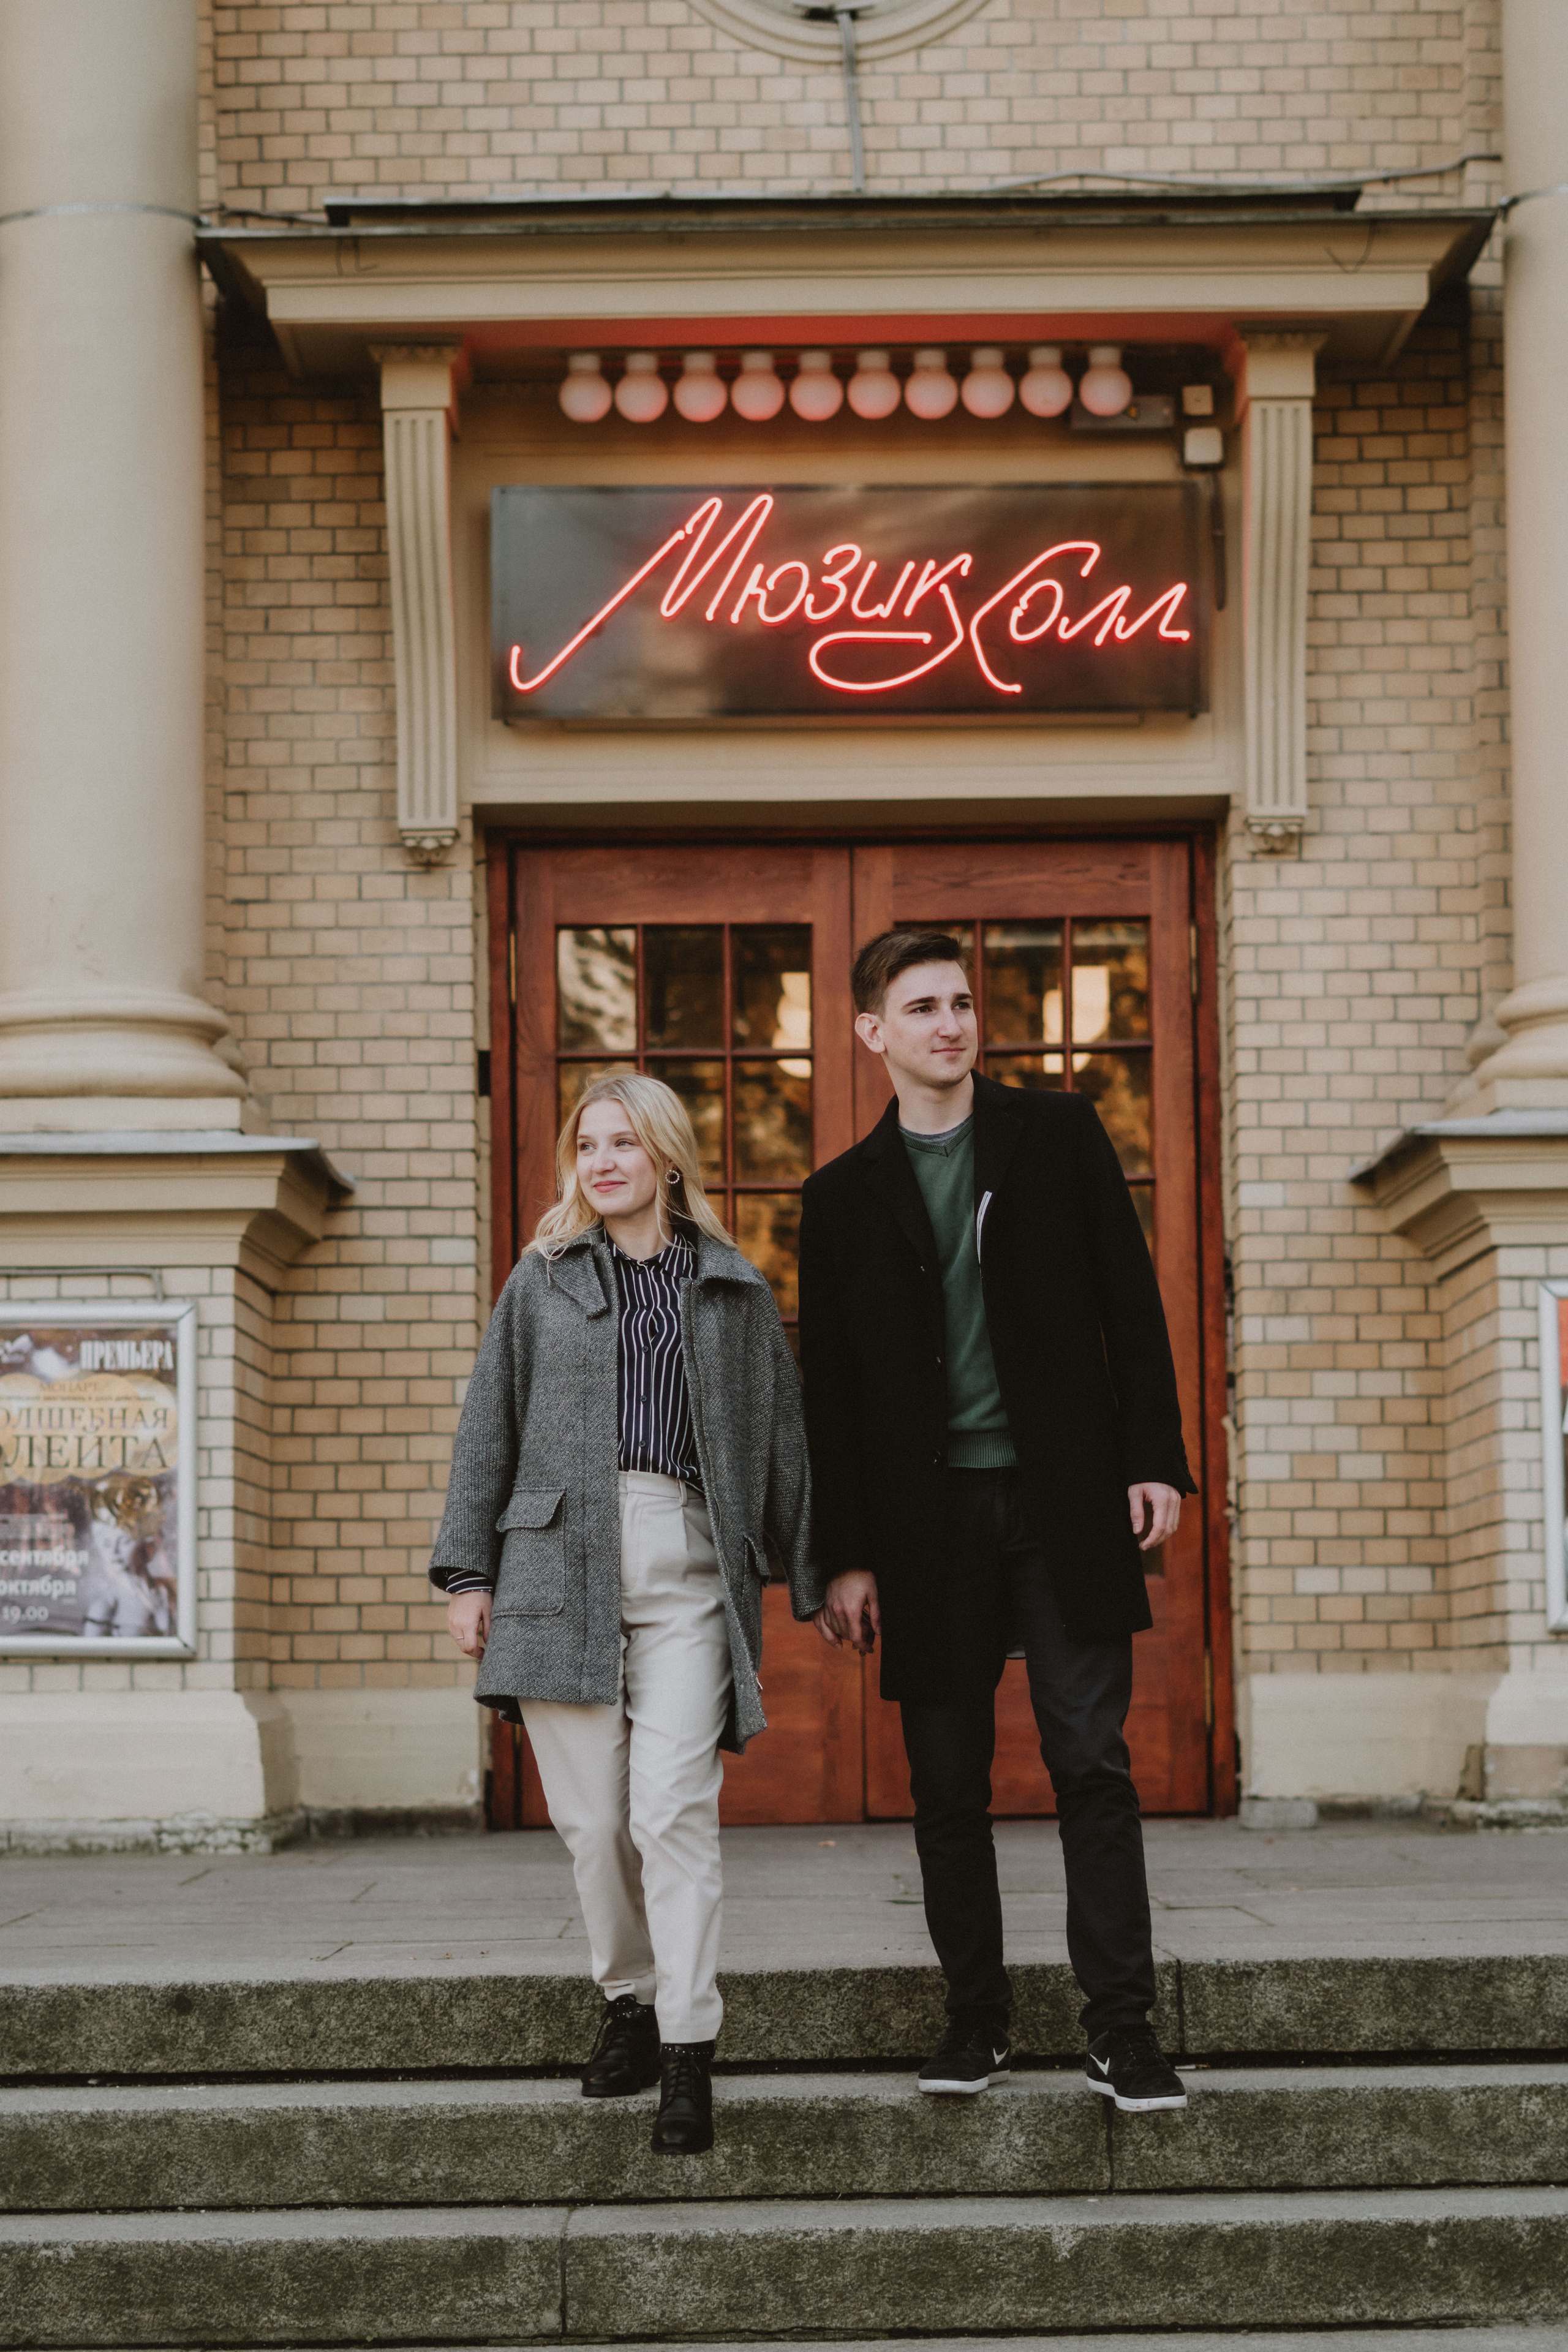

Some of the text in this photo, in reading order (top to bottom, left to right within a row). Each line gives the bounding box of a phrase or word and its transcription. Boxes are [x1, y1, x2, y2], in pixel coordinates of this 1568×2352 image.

[80, 1340, 174, 1371] ПРЕМЬЕРА
[0, 1425, 169, 1469] ЛЕЙТА
[2, 1605, 49, 1625] 19.00
